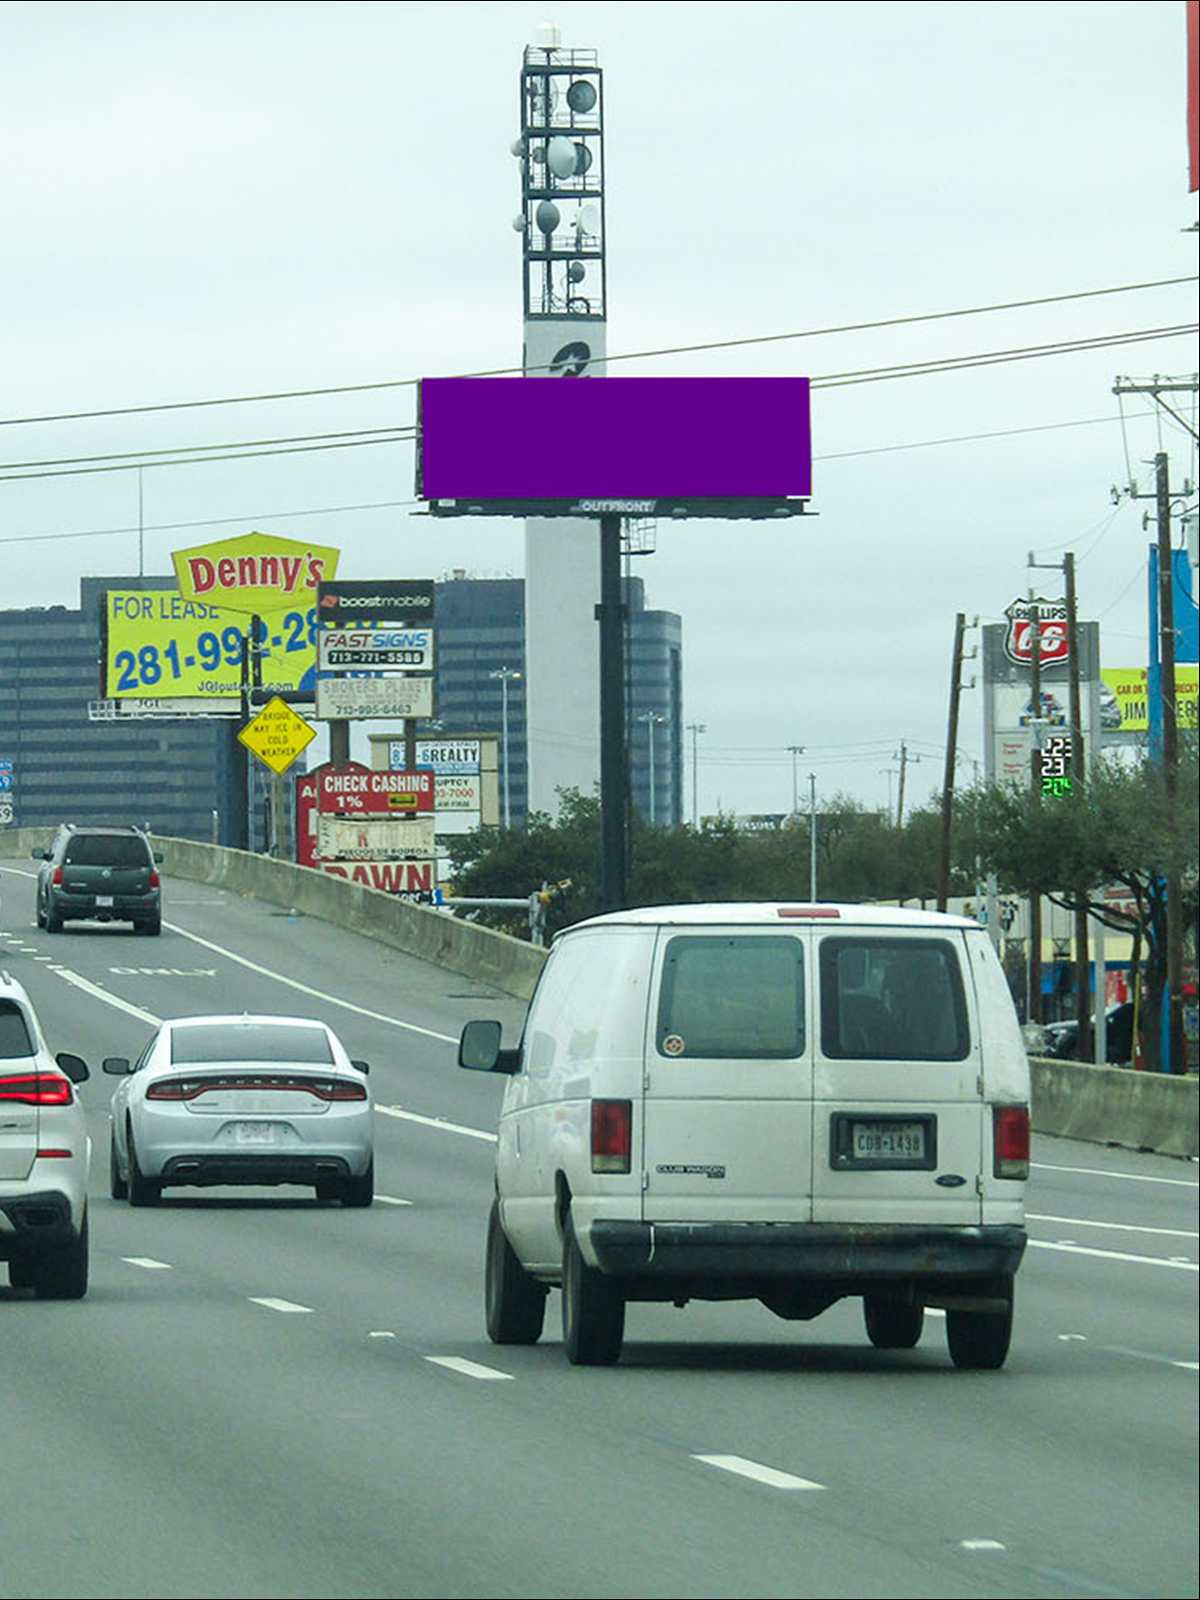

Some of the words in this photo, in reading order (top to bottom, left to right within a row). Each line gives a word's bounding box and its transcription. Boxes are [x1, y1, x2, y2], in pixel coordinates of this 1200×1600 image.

[582, 501, 652, 512] OUTFRONT
[189, 552, 325, 593] Denny's
[113, 596, 153, 619] FOR
[160, 597, 219, 619] LEASE
[1015, 607, 1067, 619] PHLIPS
[324, 633, 428, 648] FASTSIGNS
[263, 712, 291, 721] BRIDGE
[1123, 702, 1146, 720] JIM
[275, 723, 288, 732] ICE
[293, 723, 302, 731] IN
[267, 735, 289, 745] COLD
[261, 747, 296, 757] WEATHER
[324, 775, 369, 793] CHECK
[371, 775, 430, 793] CASHING
[336, 795, 363, 808] 1%
[108, 967, 218, 976] ONLY
